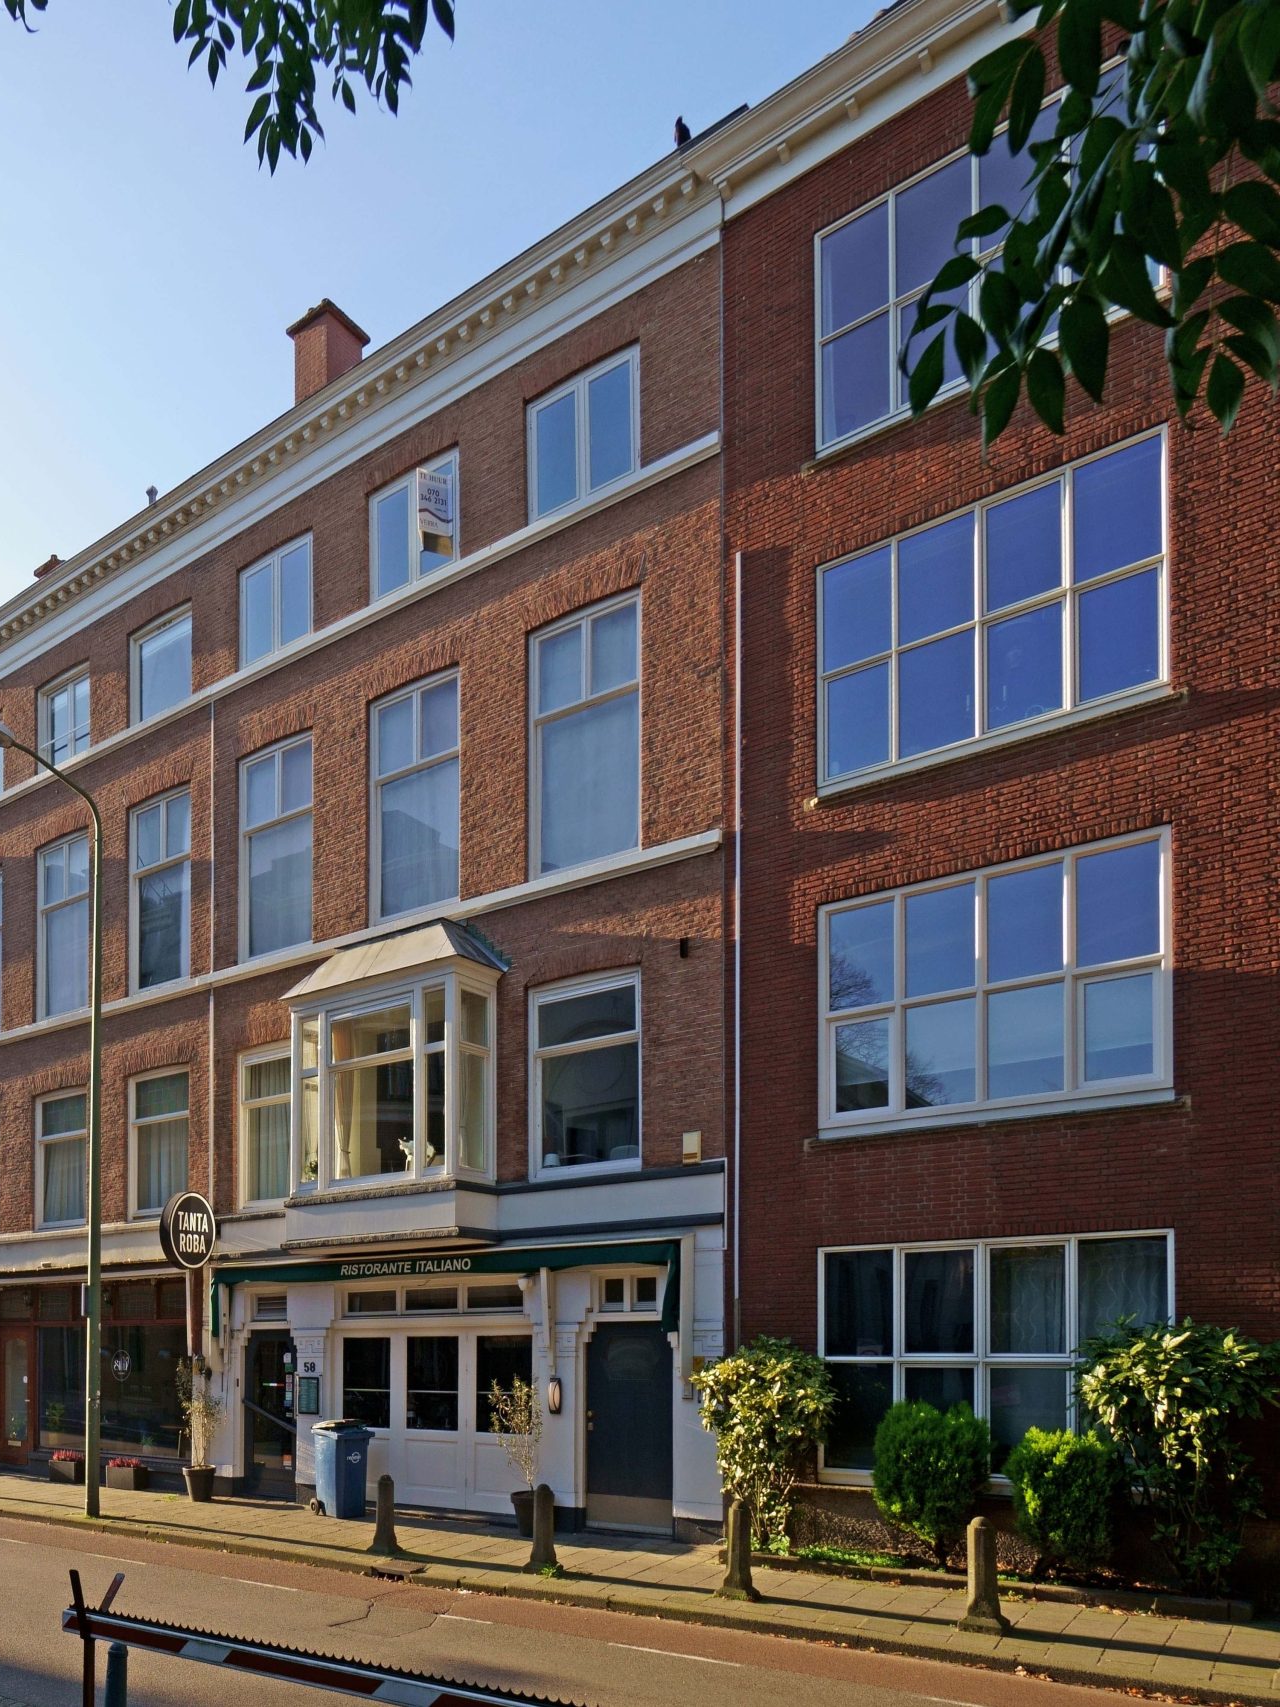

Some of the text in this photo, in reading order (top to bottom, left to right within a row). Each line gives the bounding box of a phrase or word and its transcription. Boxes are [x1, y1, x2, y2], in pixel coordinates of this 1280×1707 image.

[427, 488, 440, 497] 070
[178, 1211, 209, 1233] TANTA
[180, 1233, 206, 1254] ROBA
[340, 1258, 471, 1276] RISTORANTE ITALIANO
[303, 1362, 316, 1373] 58
